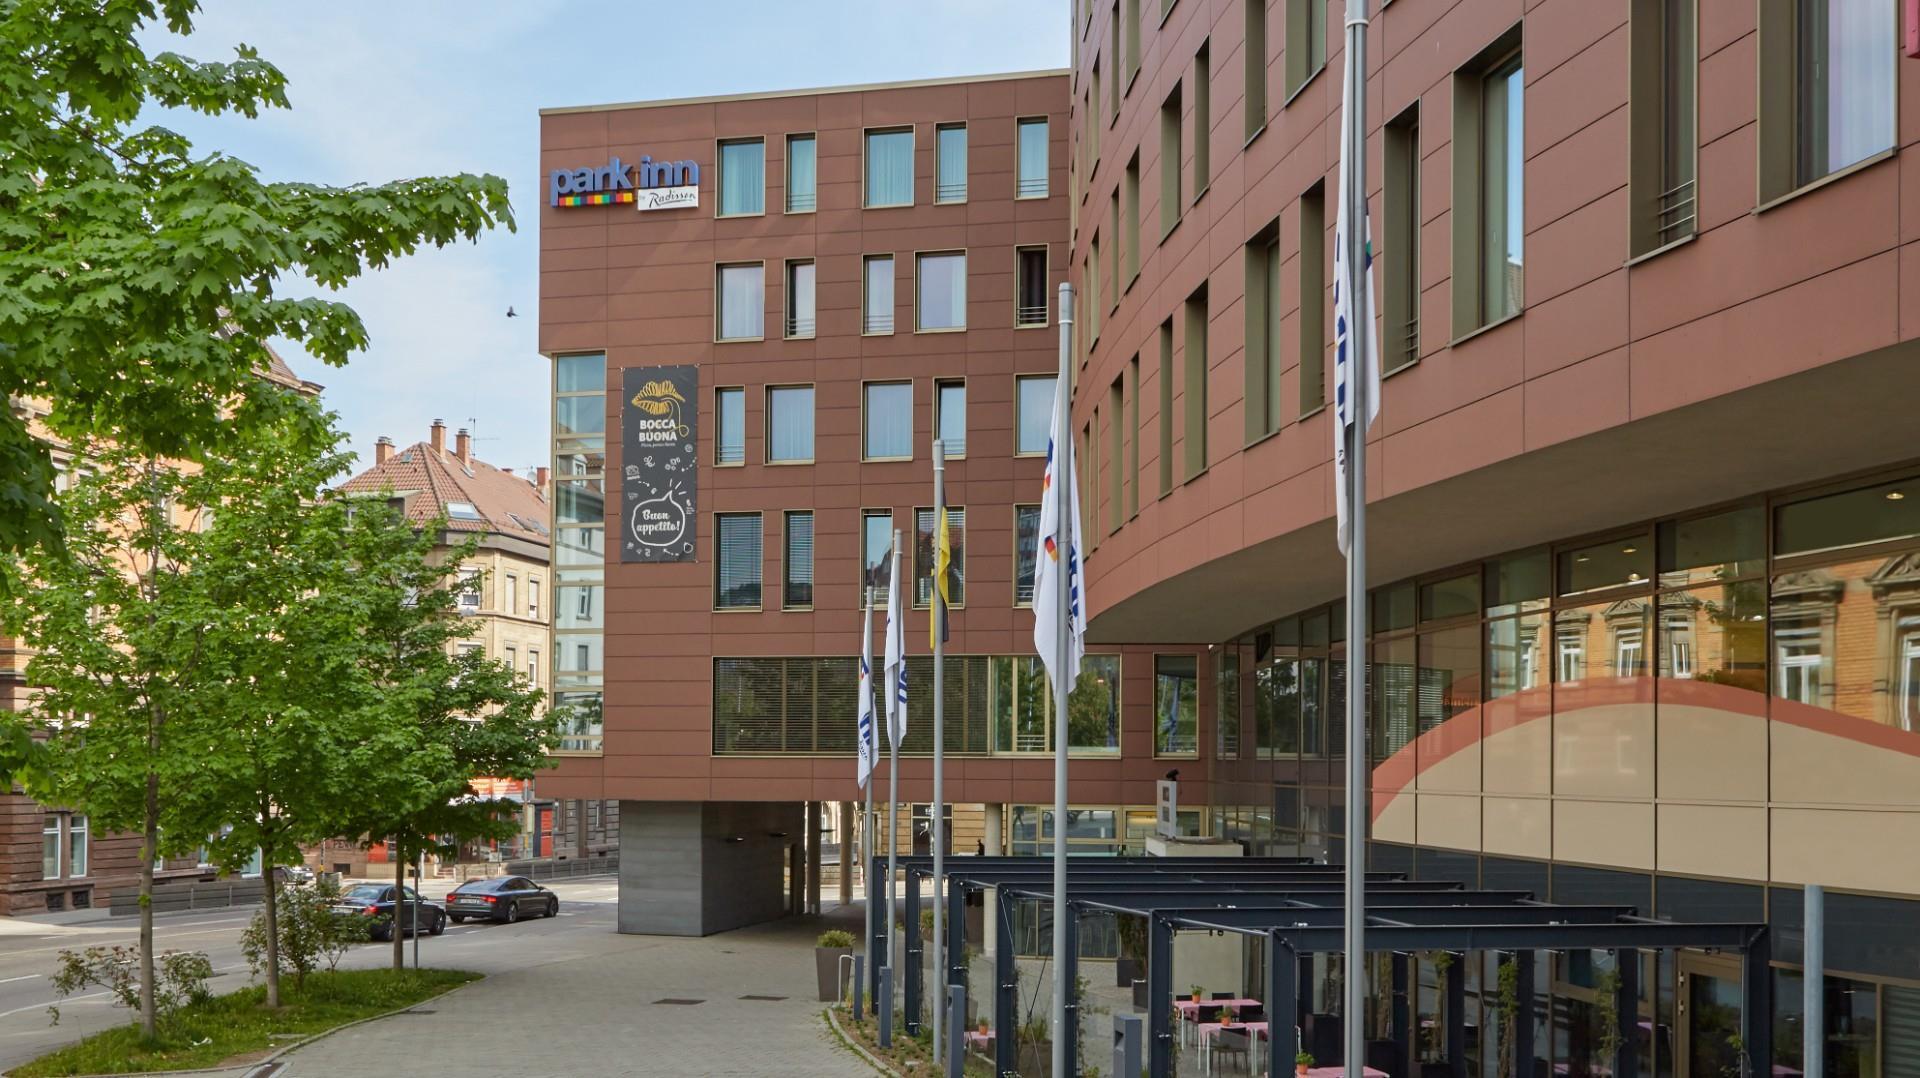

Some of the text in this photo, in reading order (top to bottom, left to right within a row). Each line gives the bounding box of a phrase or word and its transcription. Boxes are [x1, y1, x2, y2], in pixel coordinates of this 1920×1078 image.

[551, 155, 699, 208] park inn
[649, 188, 696, 208] Radisson
[640, 419, 676, 430] BOCCA
[639, 431, 677, 442] BUONA
[642, 508, 670, 520] Buon
[636, 520, 680, 536] appetito!
